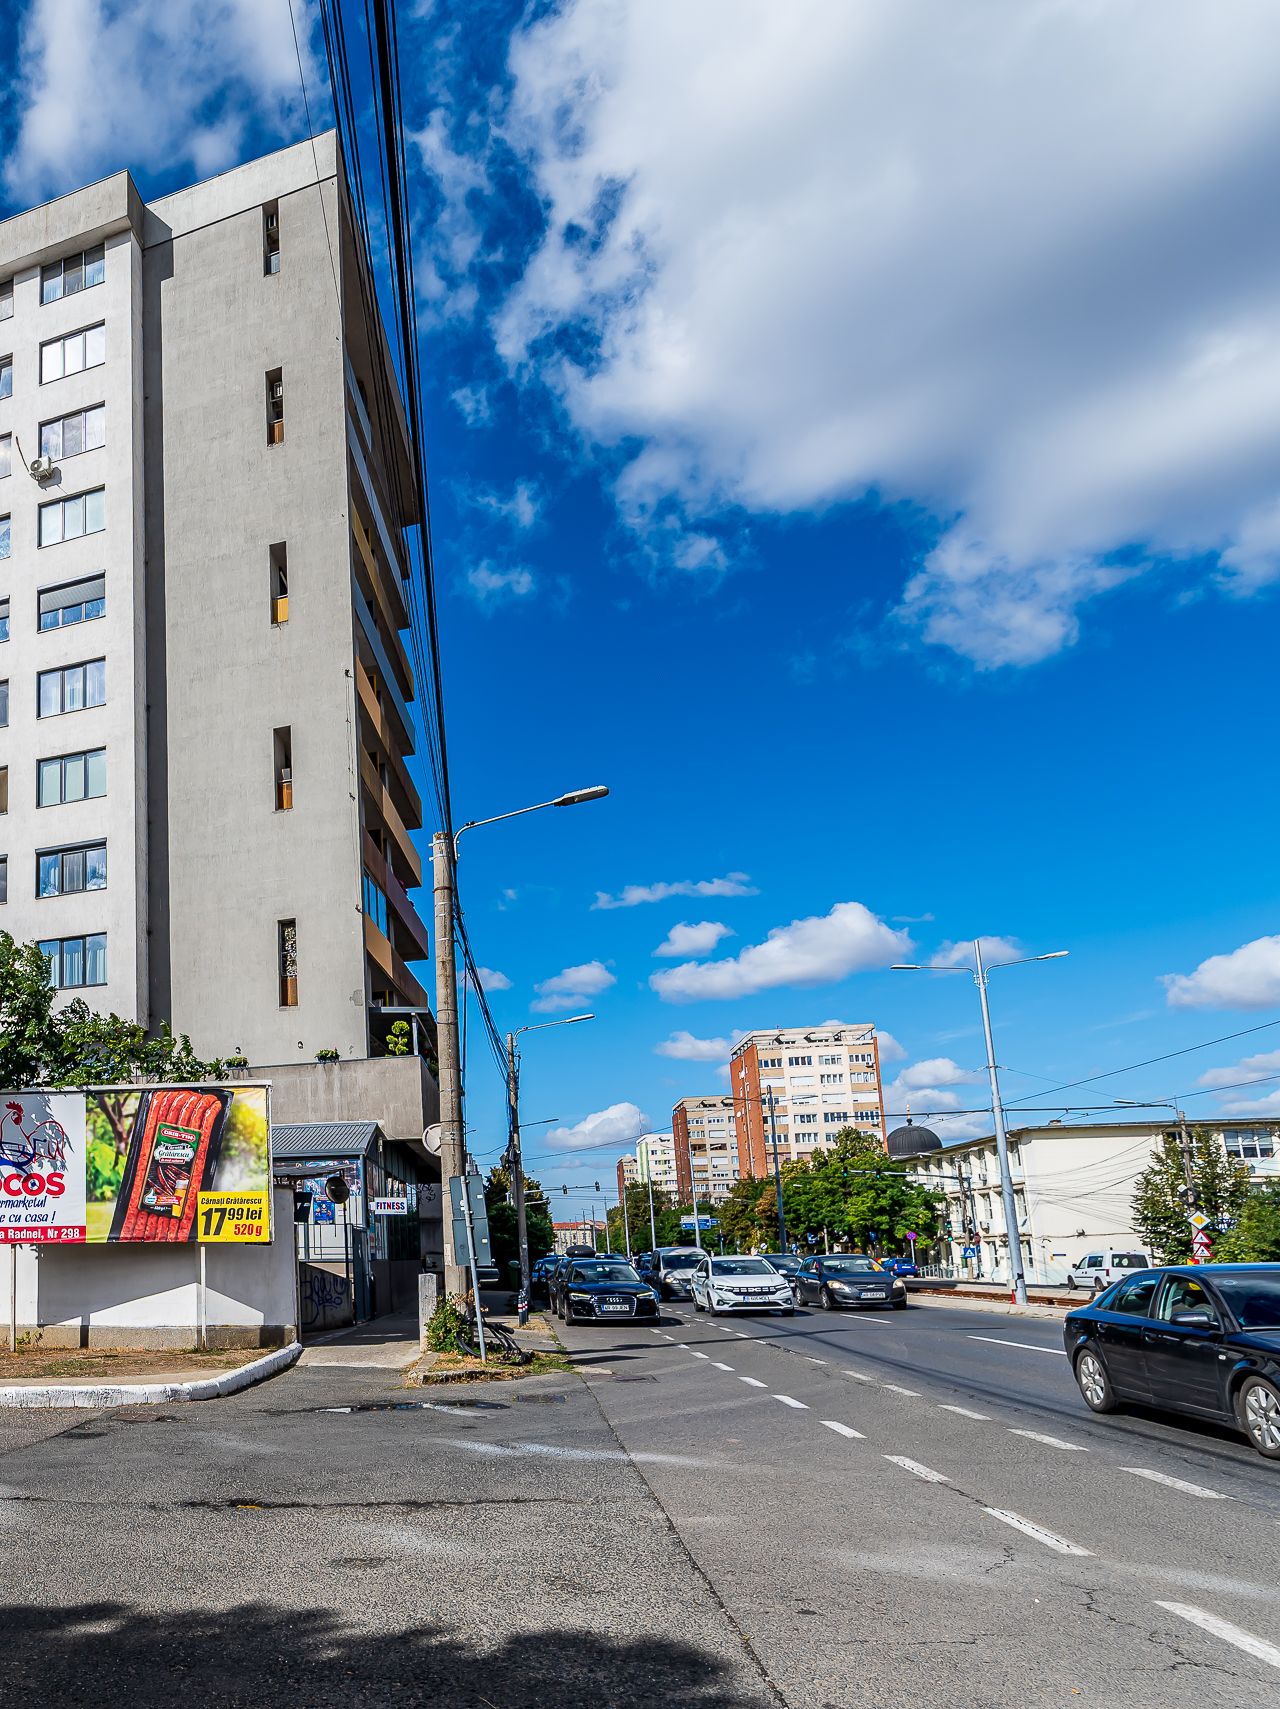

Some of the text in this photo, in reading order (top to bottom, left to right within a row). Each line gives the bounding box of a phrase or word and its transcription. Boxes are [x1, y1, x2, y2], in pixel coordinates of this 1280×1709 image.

[376, 1201, 406, 1211] FITNESS
[8, 1214, 22, 1223] cu
[245, 1207, 263, 1220] lei
[47, 1228, 58, 1239] Nr
[61, 1227, 80, 1239] 298
[233, 1223, 254, 1236] 520
